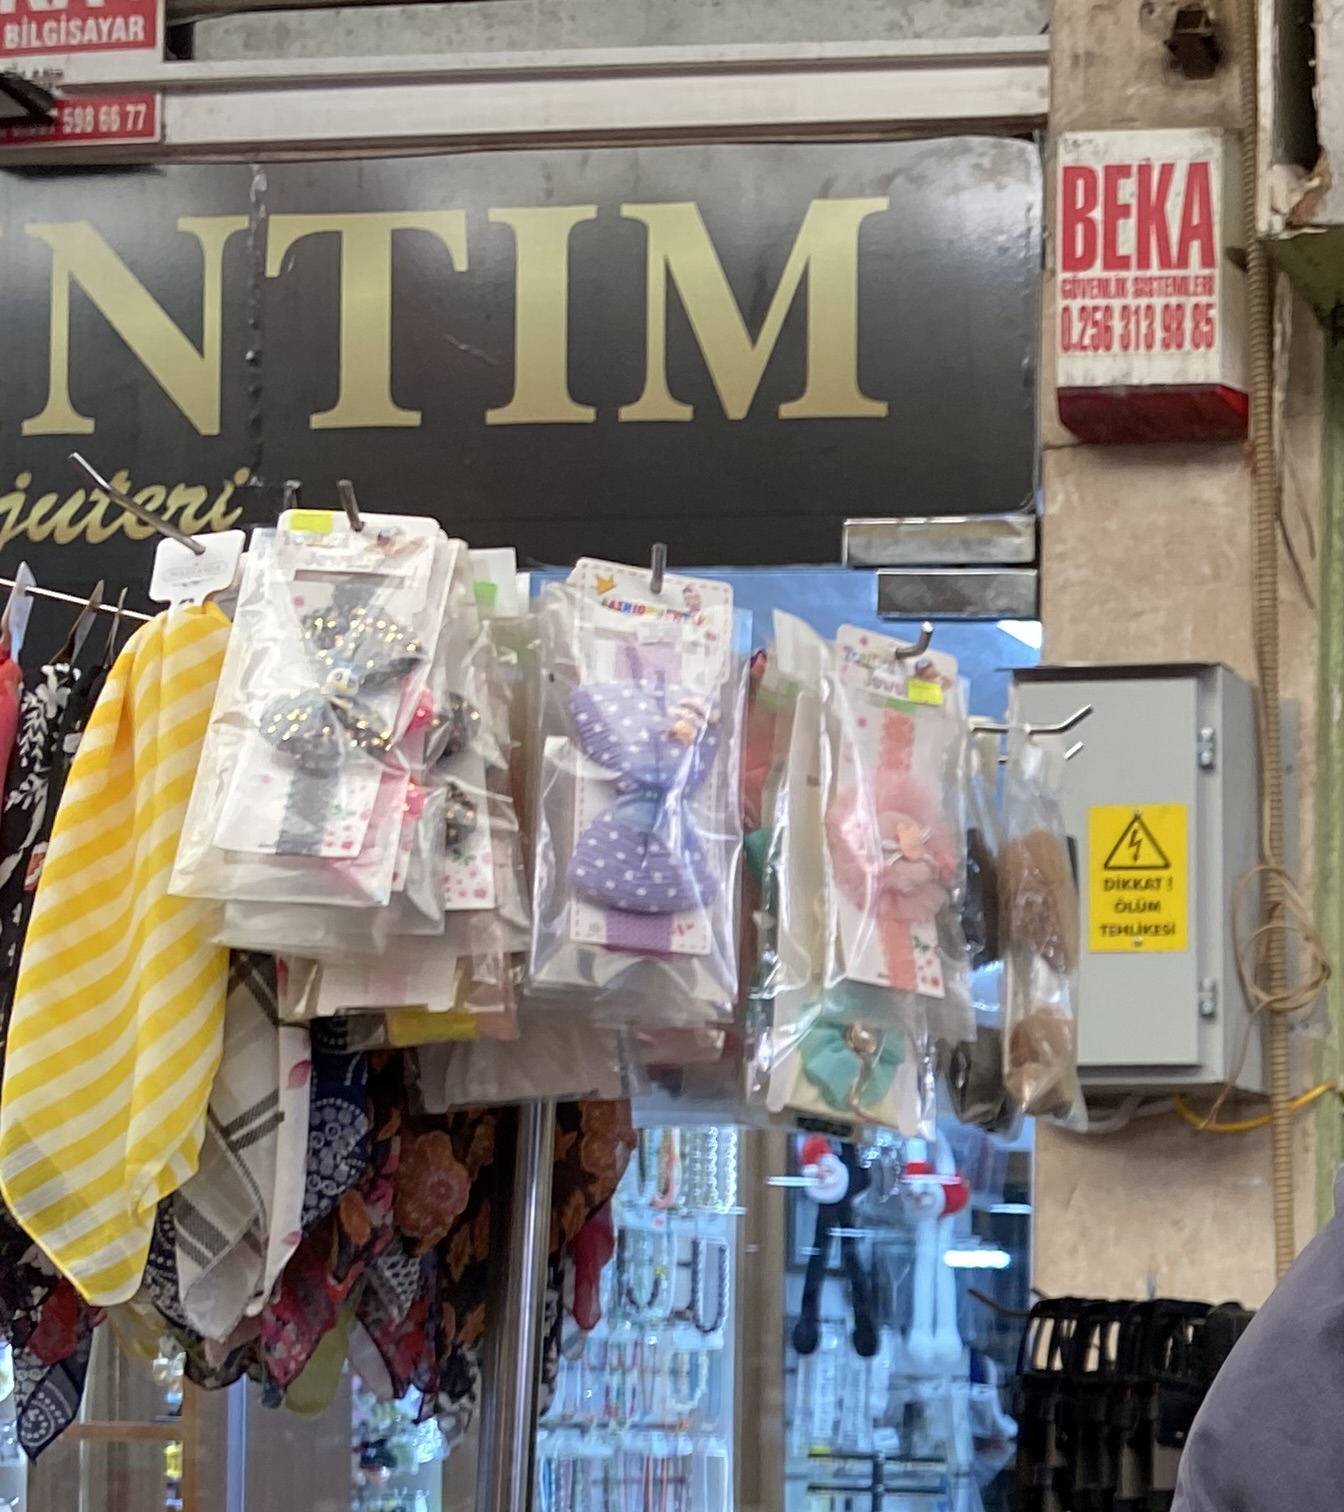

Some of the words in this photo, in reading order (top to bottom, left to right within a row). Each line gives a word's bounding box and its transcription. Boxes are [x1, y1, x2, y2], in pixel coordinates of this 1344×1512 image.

[4, 12, 145, 49] BİLGİSAYAR
[62, 106, 94, 134] 598
[99, 104, 120, 132] 66
[126, 103, 146, 131] 77
[1062, 162, 1216, 271] BEKA
[20, 197, 889, 436] NTIM
[1119, 304, 1155, 352] 313
[1104, 874, 1162, 892] DİKKAT
[1114, 898, 1161, 914] ÖLÜM
